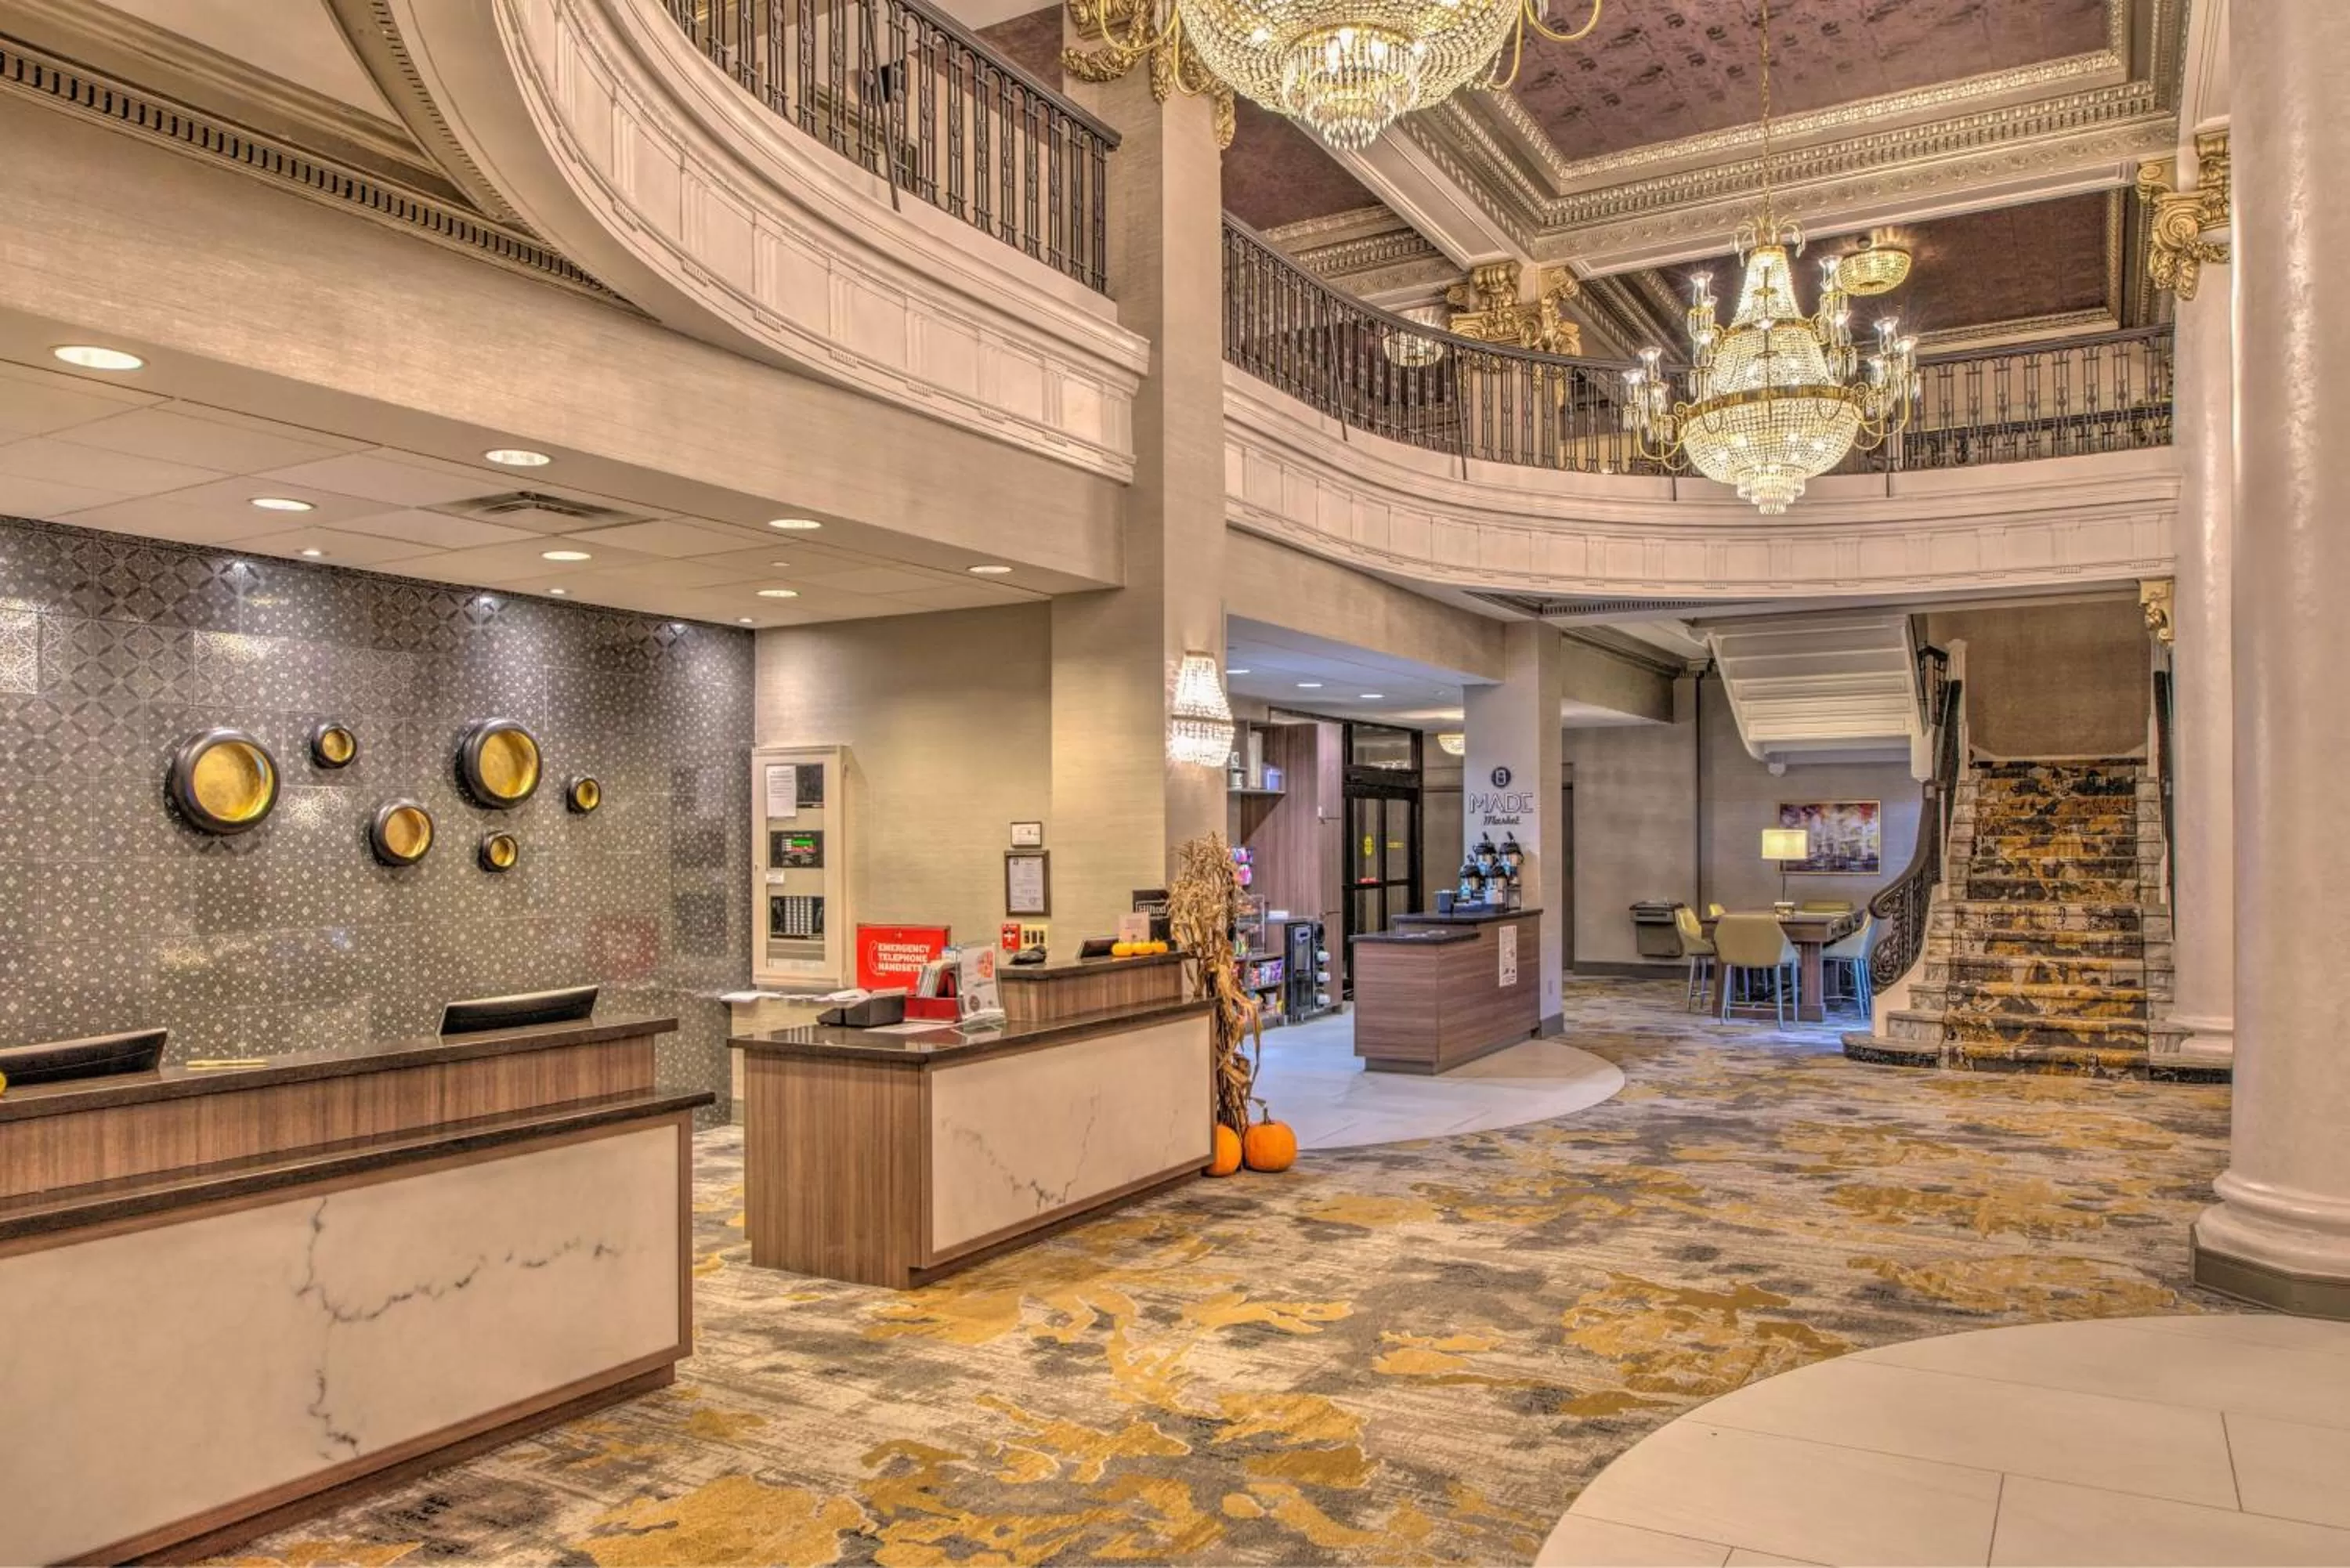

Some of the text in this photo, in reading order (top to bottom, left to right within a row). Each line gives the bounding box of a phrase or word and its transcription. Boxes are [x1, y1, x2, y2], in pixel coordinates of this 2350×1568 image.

[1470, 793, 1533, 813] MADE
[1483, 815, 1520, 826] Market
[877, 943, 931, 953] EMERGENCY
[877, 952, 928, 963] TELEPHONE
